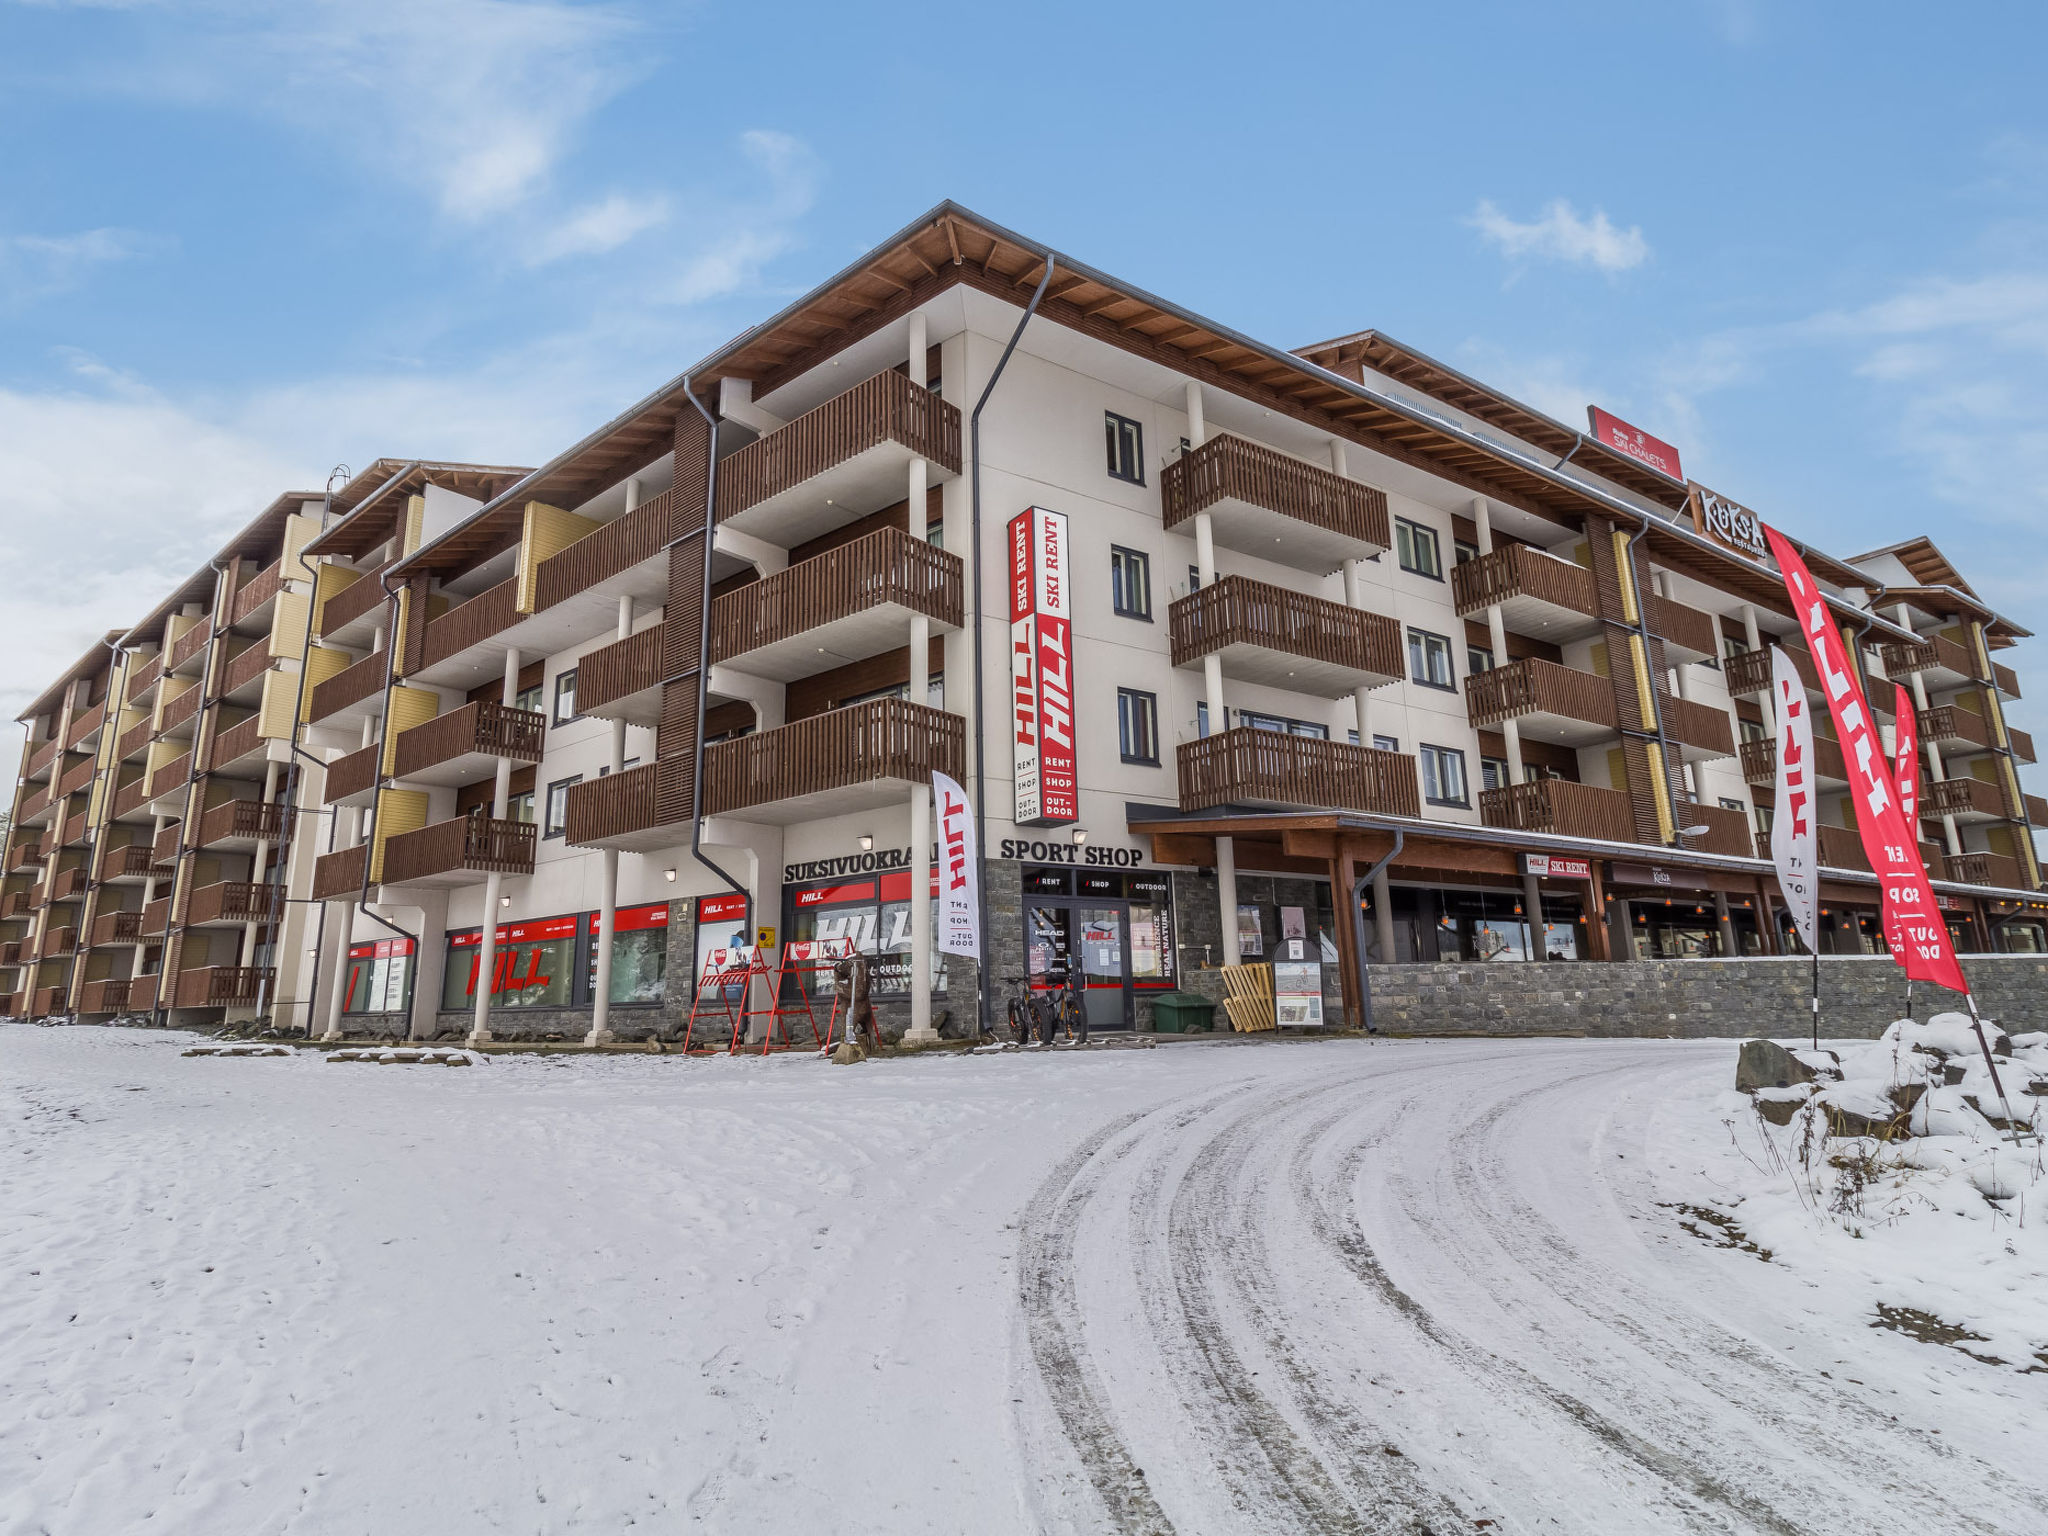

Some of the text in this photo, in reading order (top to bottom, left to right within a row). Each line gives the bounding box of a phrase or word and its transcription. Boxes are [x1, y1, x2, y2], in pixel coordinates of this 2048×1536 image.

[1629, 443, 1667, 470] CHALETS
[1015, 521, 1028, 611] SKI RENT
[1044, 516, 1060, 609] SKI RENT
[1015, 622, 1036, 746] HILL
[1041, 622, 1071, 750] HILL
[1017, 758, 1036, 770] RENT
[1045, 756, 1071, 768] RENT
[1018, 778, 1036, 790] SHOP
[1045, 777, 1072, 788] SHOP
[1018, 799, 1036, 809] OUT-
[1046, 797, 1071, 806] OUT-
[1018, 807, 1037, 818] DOOR
[1046, 806, 1073, 816] DOOR
[1001, 839, 1143, 867] SPORT SHOP
[785, 843, 939, 882] SUKSIVUOKRA
[1550, 860, 1565, 872] SKI
[1565, 862, 1588, 874] RENT
[1091, 880, 1110, 888] SHOP
[801, 892, 824, 903] HILL
[704, 904, 723, 914] HILL
[816, 911, 912, 951] HILL
[1086, 931, 1116, 940] HILL
[1161, 910, 1171, 977] REAL NATURE
